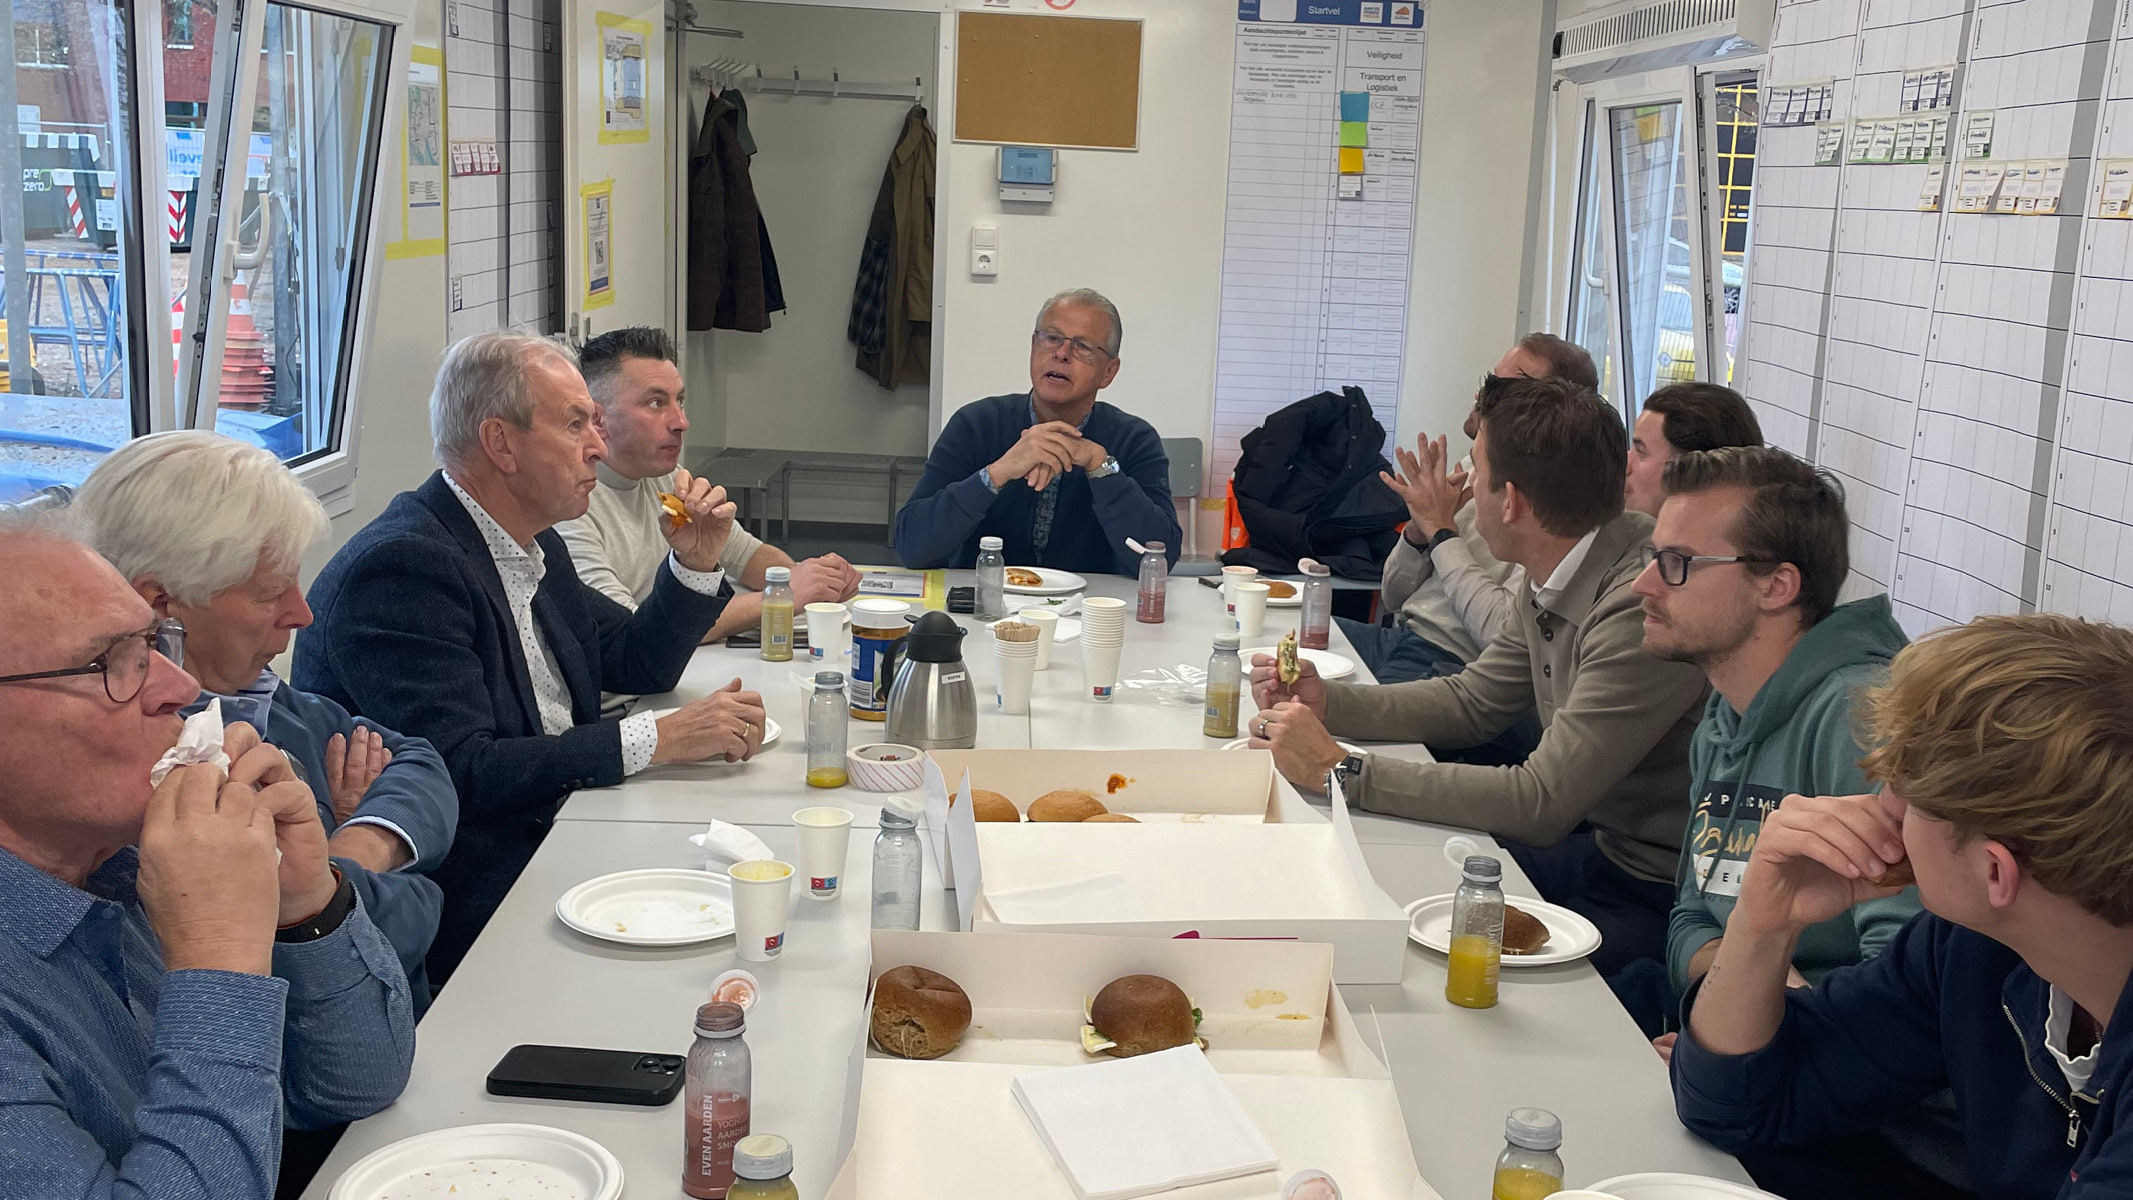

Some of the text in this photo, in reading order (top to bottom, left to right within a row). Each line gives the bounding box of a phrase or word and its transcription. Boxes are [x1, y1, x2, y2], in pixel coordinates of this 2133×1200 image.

[1367, 51, 1403, 61] Veiligheid
[1360, 72, 1395, 83] Transport
[1367, 83, 1398, 92] Logistiek
[23, 168, 39, 180] pre
[23, 181, 45, 192] zero
[702, 1095, 713, 1176] EVEN AARDEN
[717, 1139, 736, 1150] SMO
